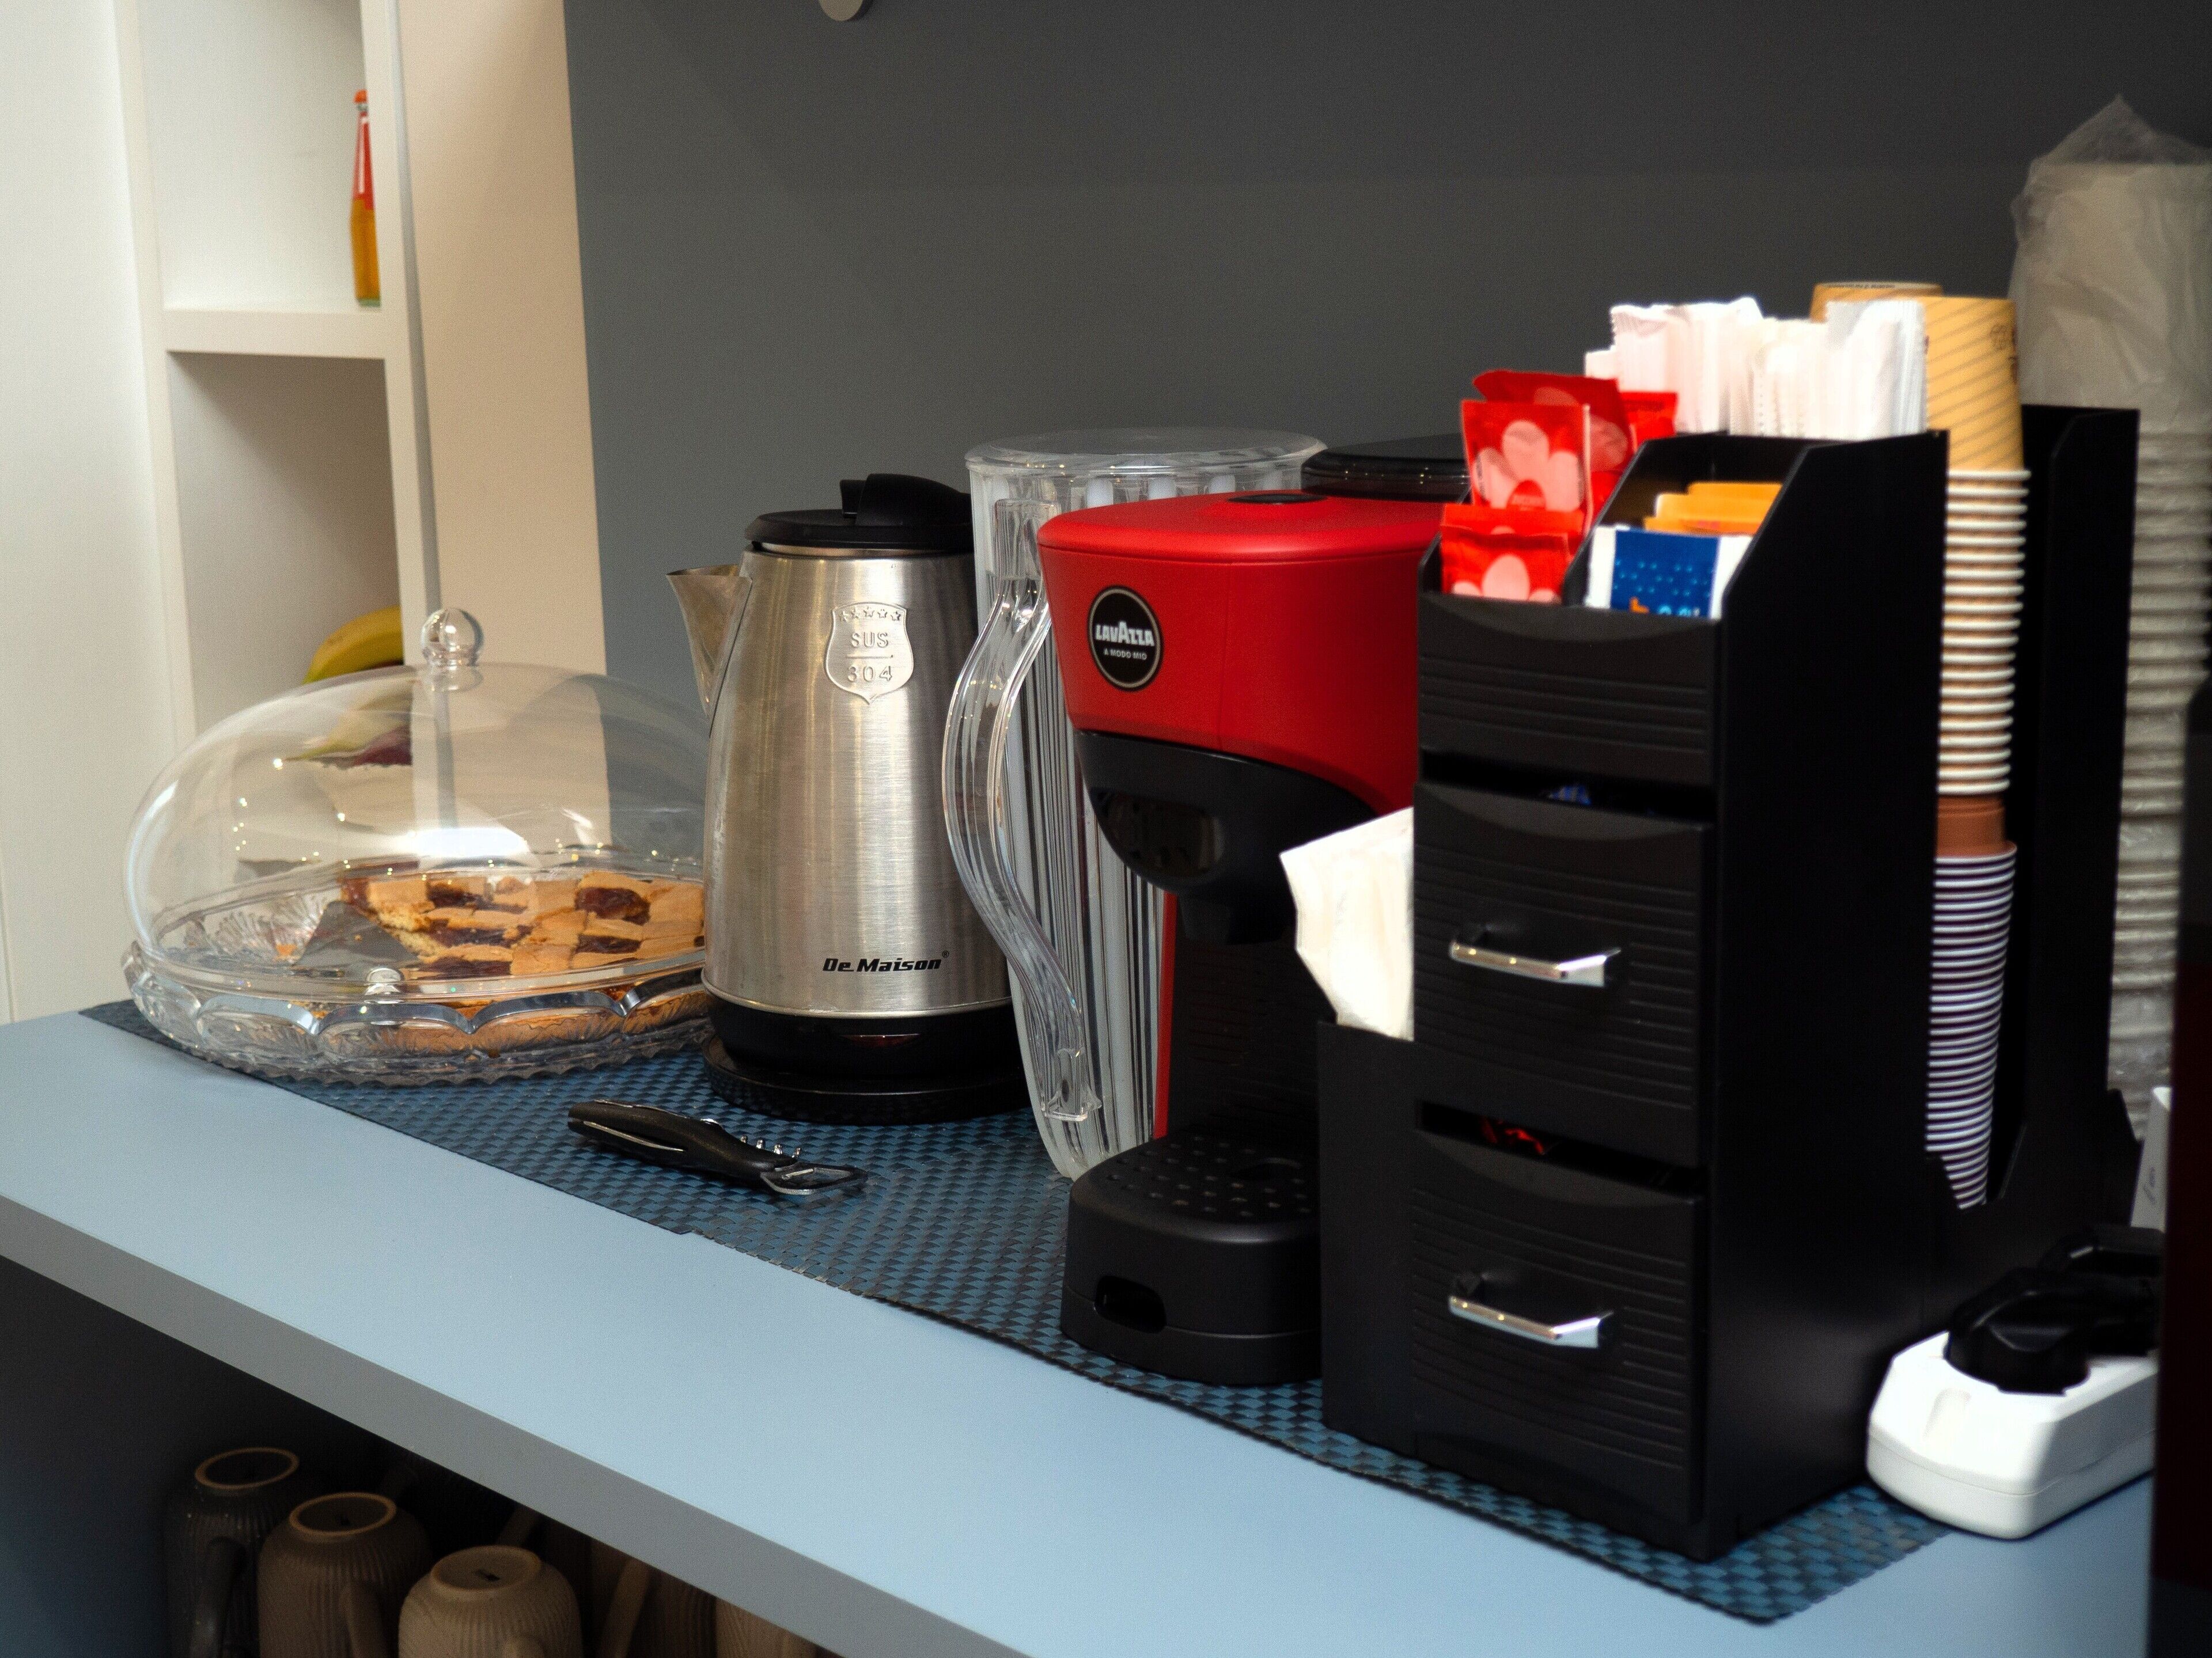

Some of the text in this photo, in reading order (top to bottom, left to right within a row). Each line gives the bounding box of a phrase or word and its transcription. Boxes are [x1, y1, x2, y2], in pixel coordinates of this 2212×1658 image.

[850, 632, 889, 648] SUS
[1096, 621, 1155, 647] LAVAZZA
[1110, 649, 1131, 659] MODO
[1133, 652, 1147, 661] MIO
[847, 666, 893, 682] 304
